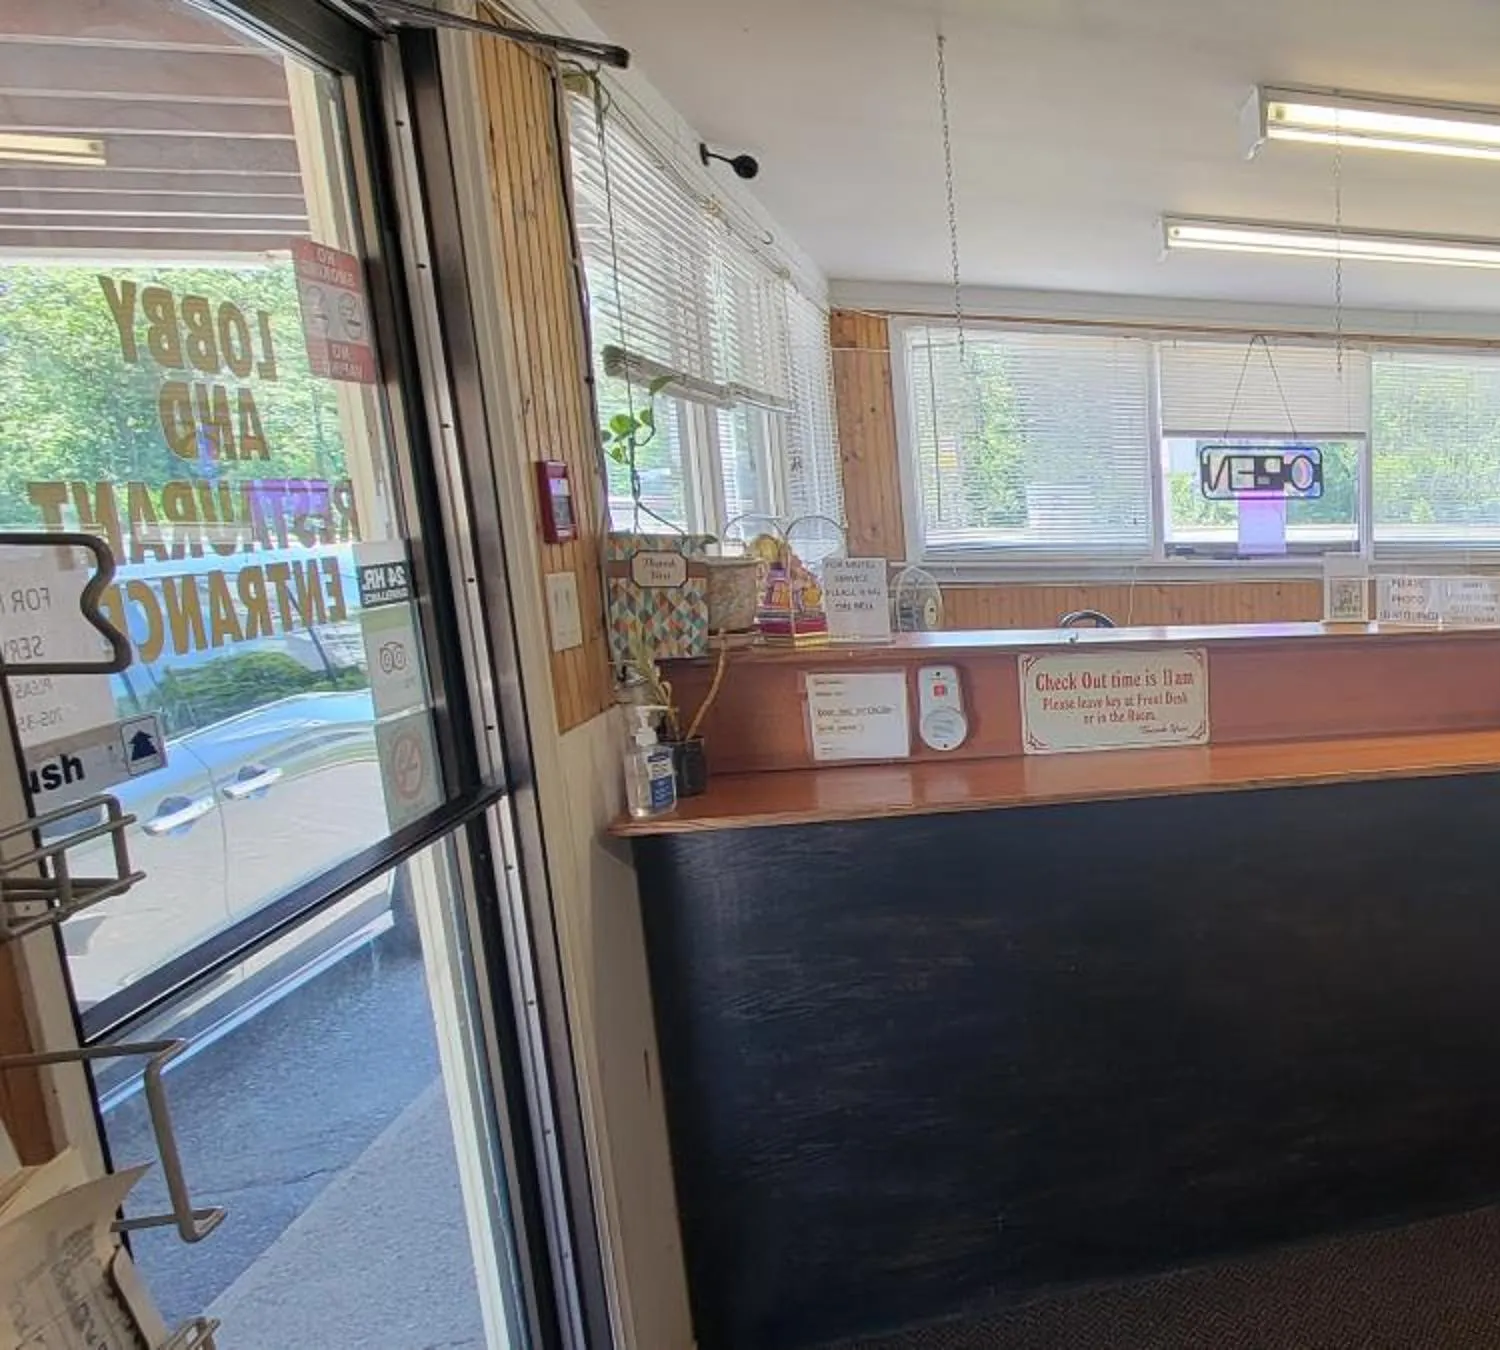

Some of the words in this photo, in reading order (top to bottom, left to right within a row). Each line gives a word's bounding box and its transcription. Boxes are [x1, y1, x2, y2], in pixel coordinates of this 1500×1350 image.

[1036, 671, 1078, 692] Check
[1082, 671, 1107, 690] Out
[1111, 669, 1141, 688] time
[1145, 668, 1157, 687] is
[1043, 697, 1074, 711] Please
[1109, 710, 1125, 723] the
[30, 753, 85, 795] ush
